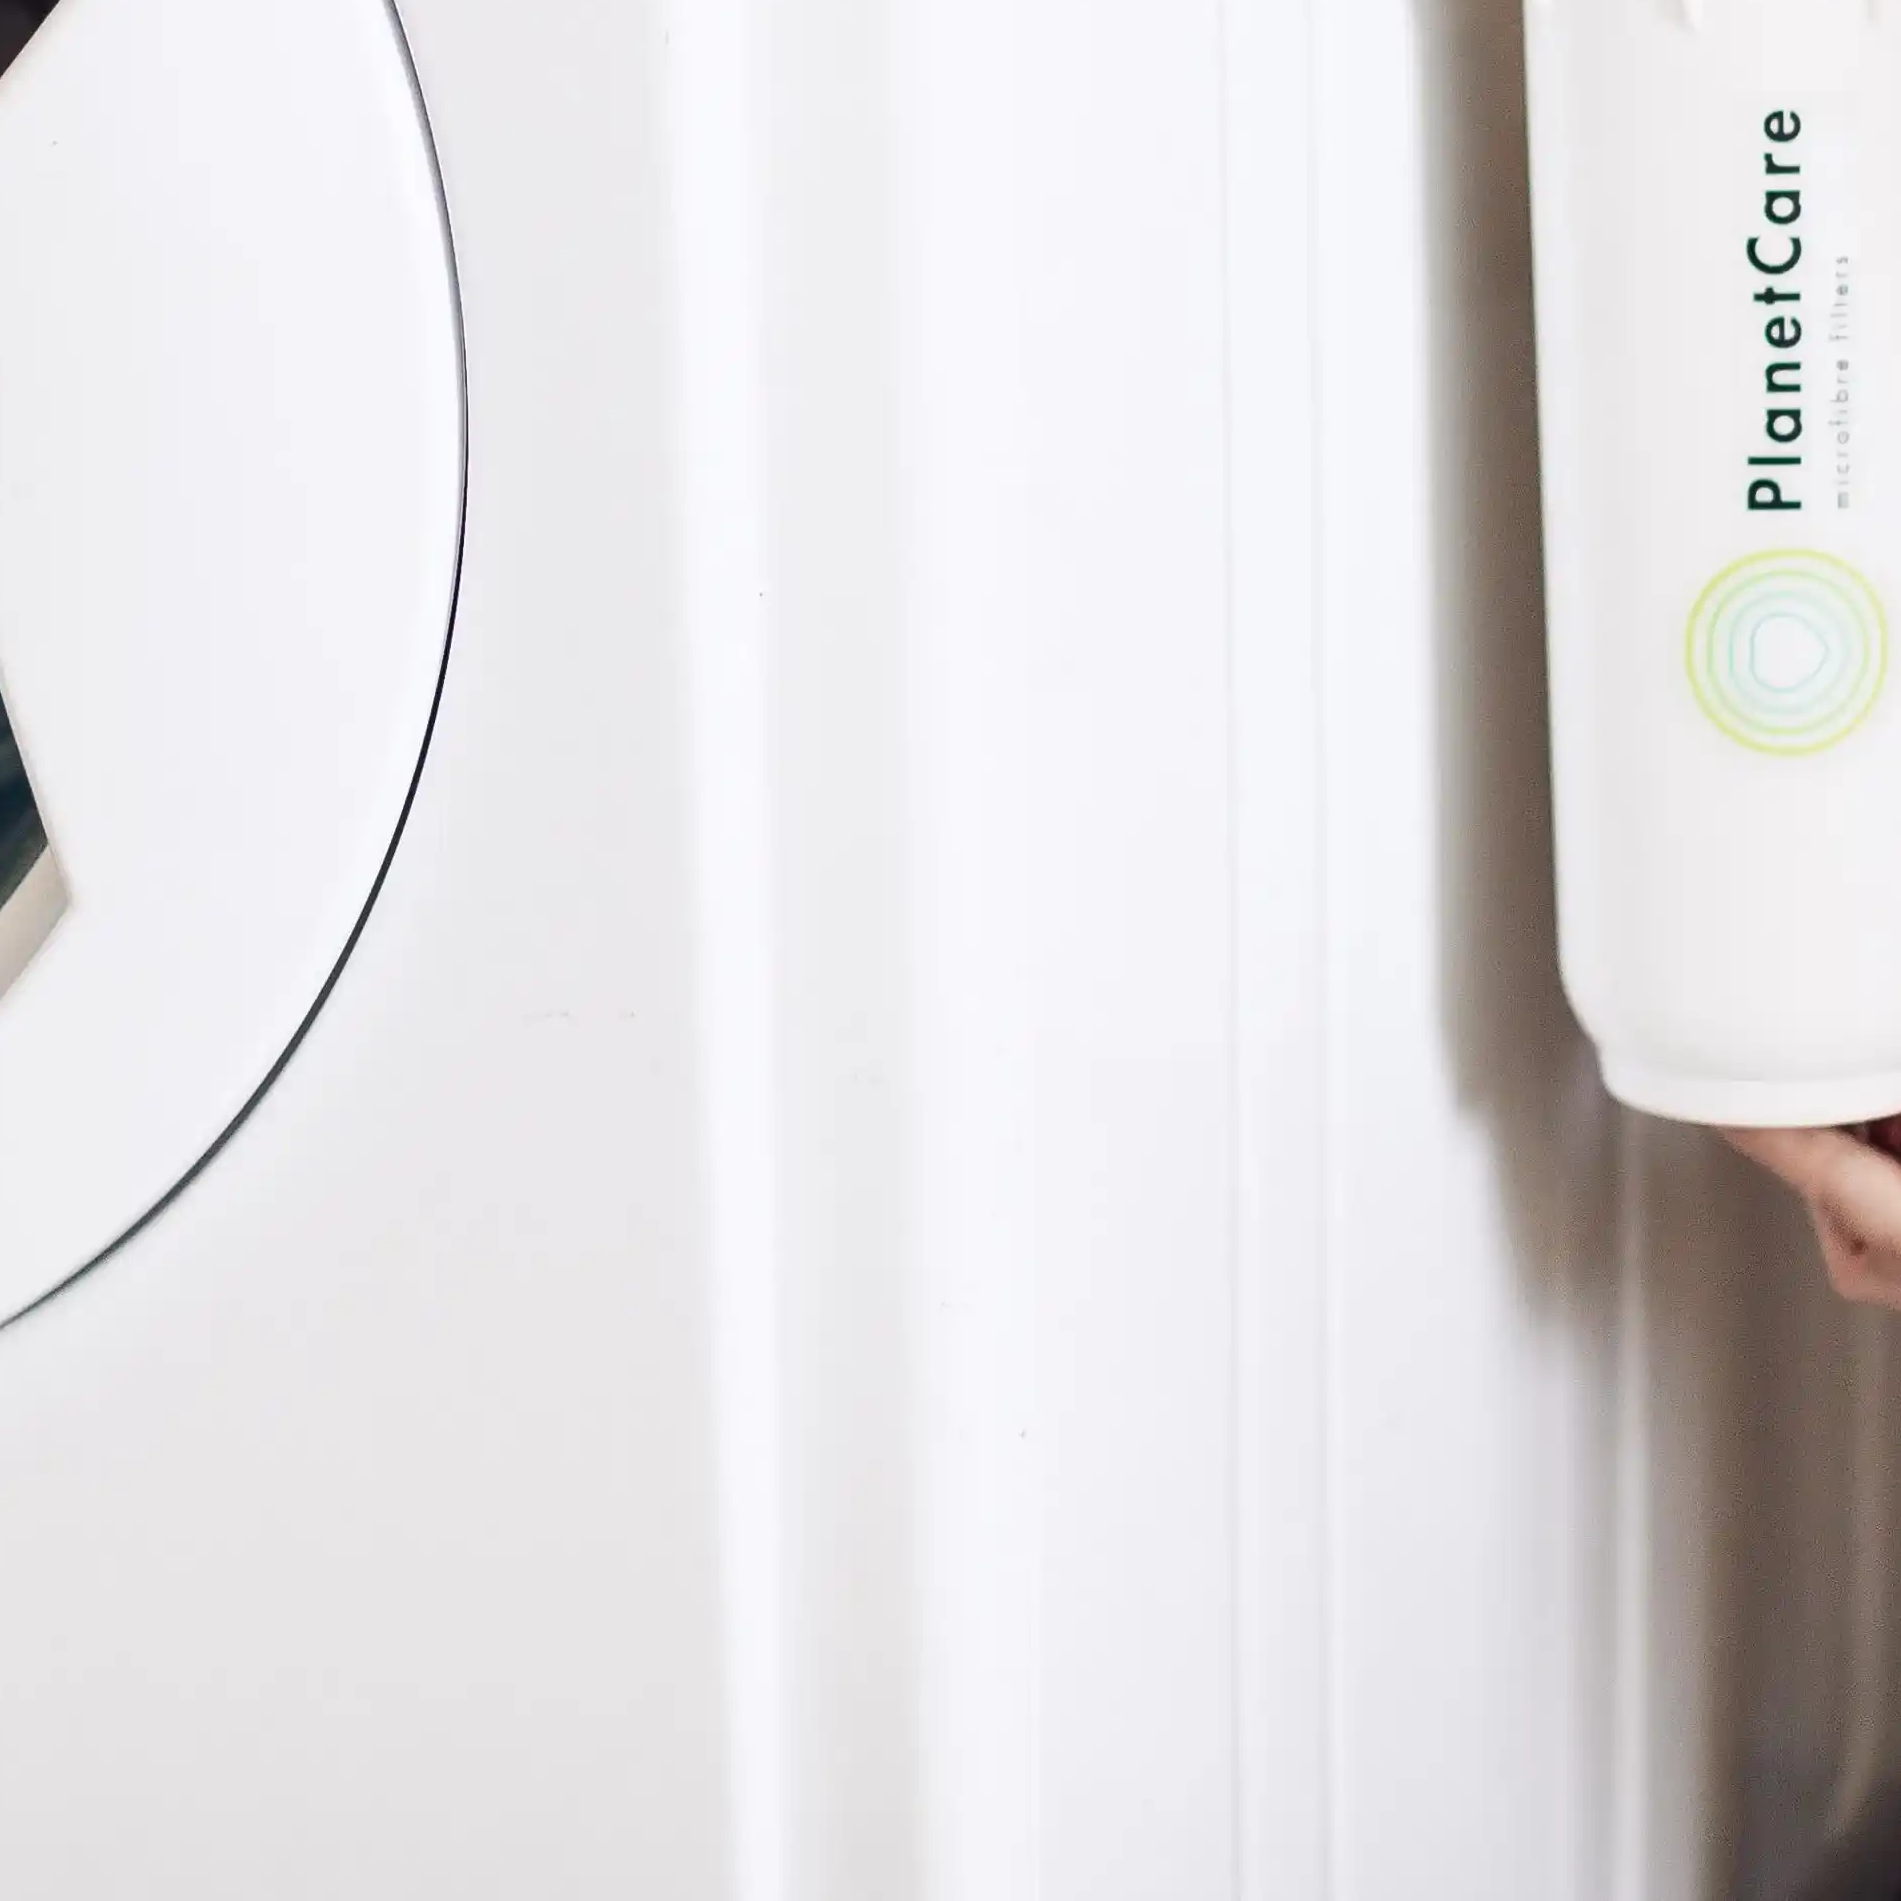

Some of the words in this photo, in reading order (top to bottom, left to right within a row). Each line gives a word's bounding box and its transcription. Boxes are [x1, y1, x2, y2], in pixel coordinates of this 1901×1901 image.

[1746, 111, 1802, 510] PlanetCare
[1830, 257, 1848, 340] filters
[1829, 360, 1849, 508] microfibre
